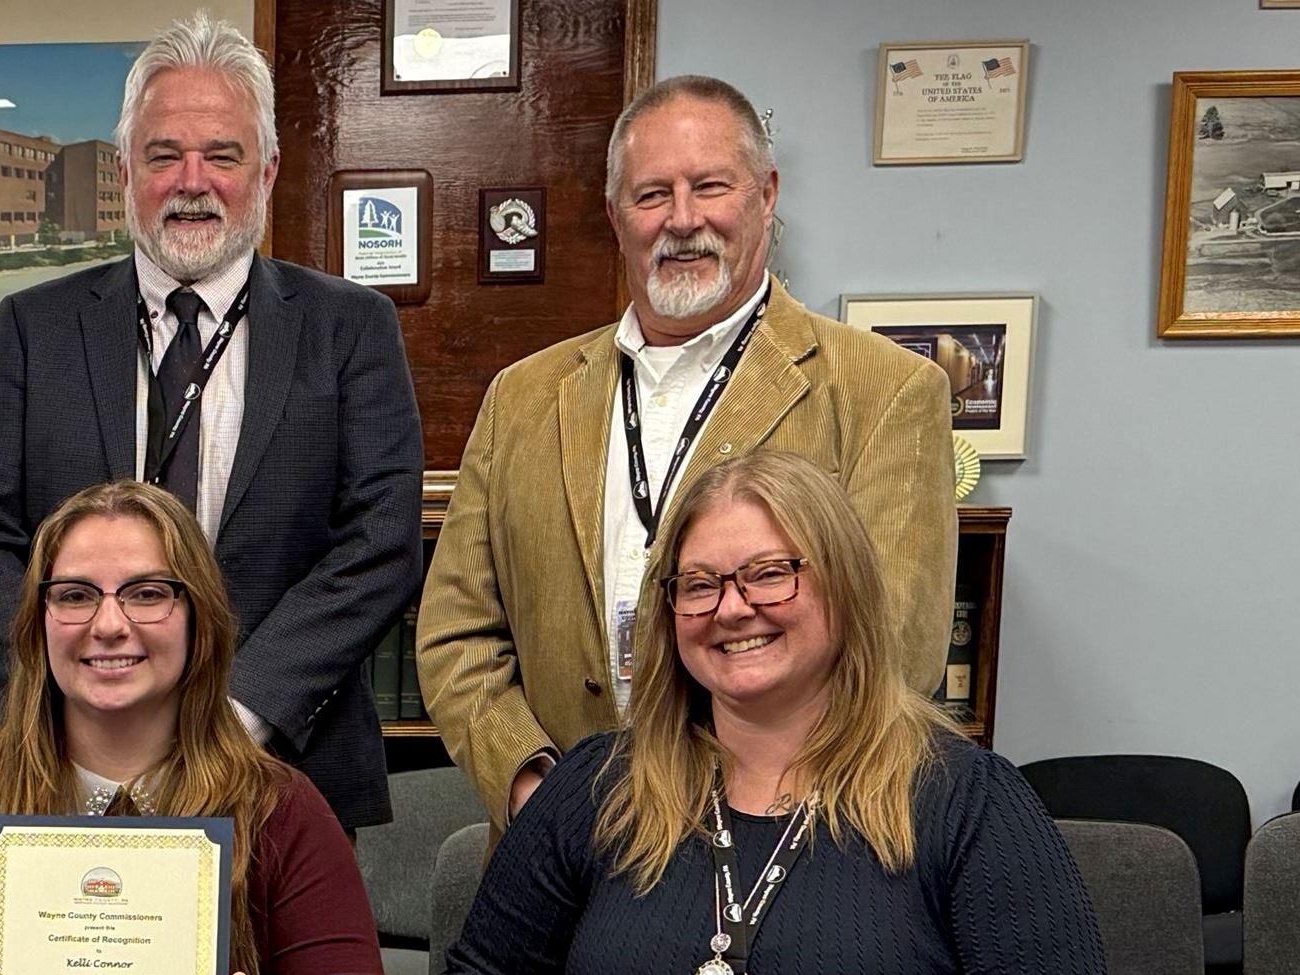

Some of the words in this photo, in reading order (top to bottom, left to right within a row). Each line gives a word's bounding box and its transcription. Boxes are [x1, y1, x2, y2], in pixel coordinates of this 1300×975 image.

[934, 73, 950, 81] THE
[952, 73, 972, 81] FLAG
[922, 88, 951, 96] UNITED
[952, 86, 983, 95] STATES
[927, 95, 938, 103] OF
[939, 94, 975, 103] AMERICA
[358, 239, 403, 249] NOSORH
[38, 911, 66, 920] Wayne
[68, 912, 97, 921] County
[99, 913, 163, 921] Commissioners
[48, 934, 89, 943] Certificate
[102, 936, 151, 945] Recognition
[66, 958, 91, 968] Kelli
[93, 960, 133, 968] Connor
